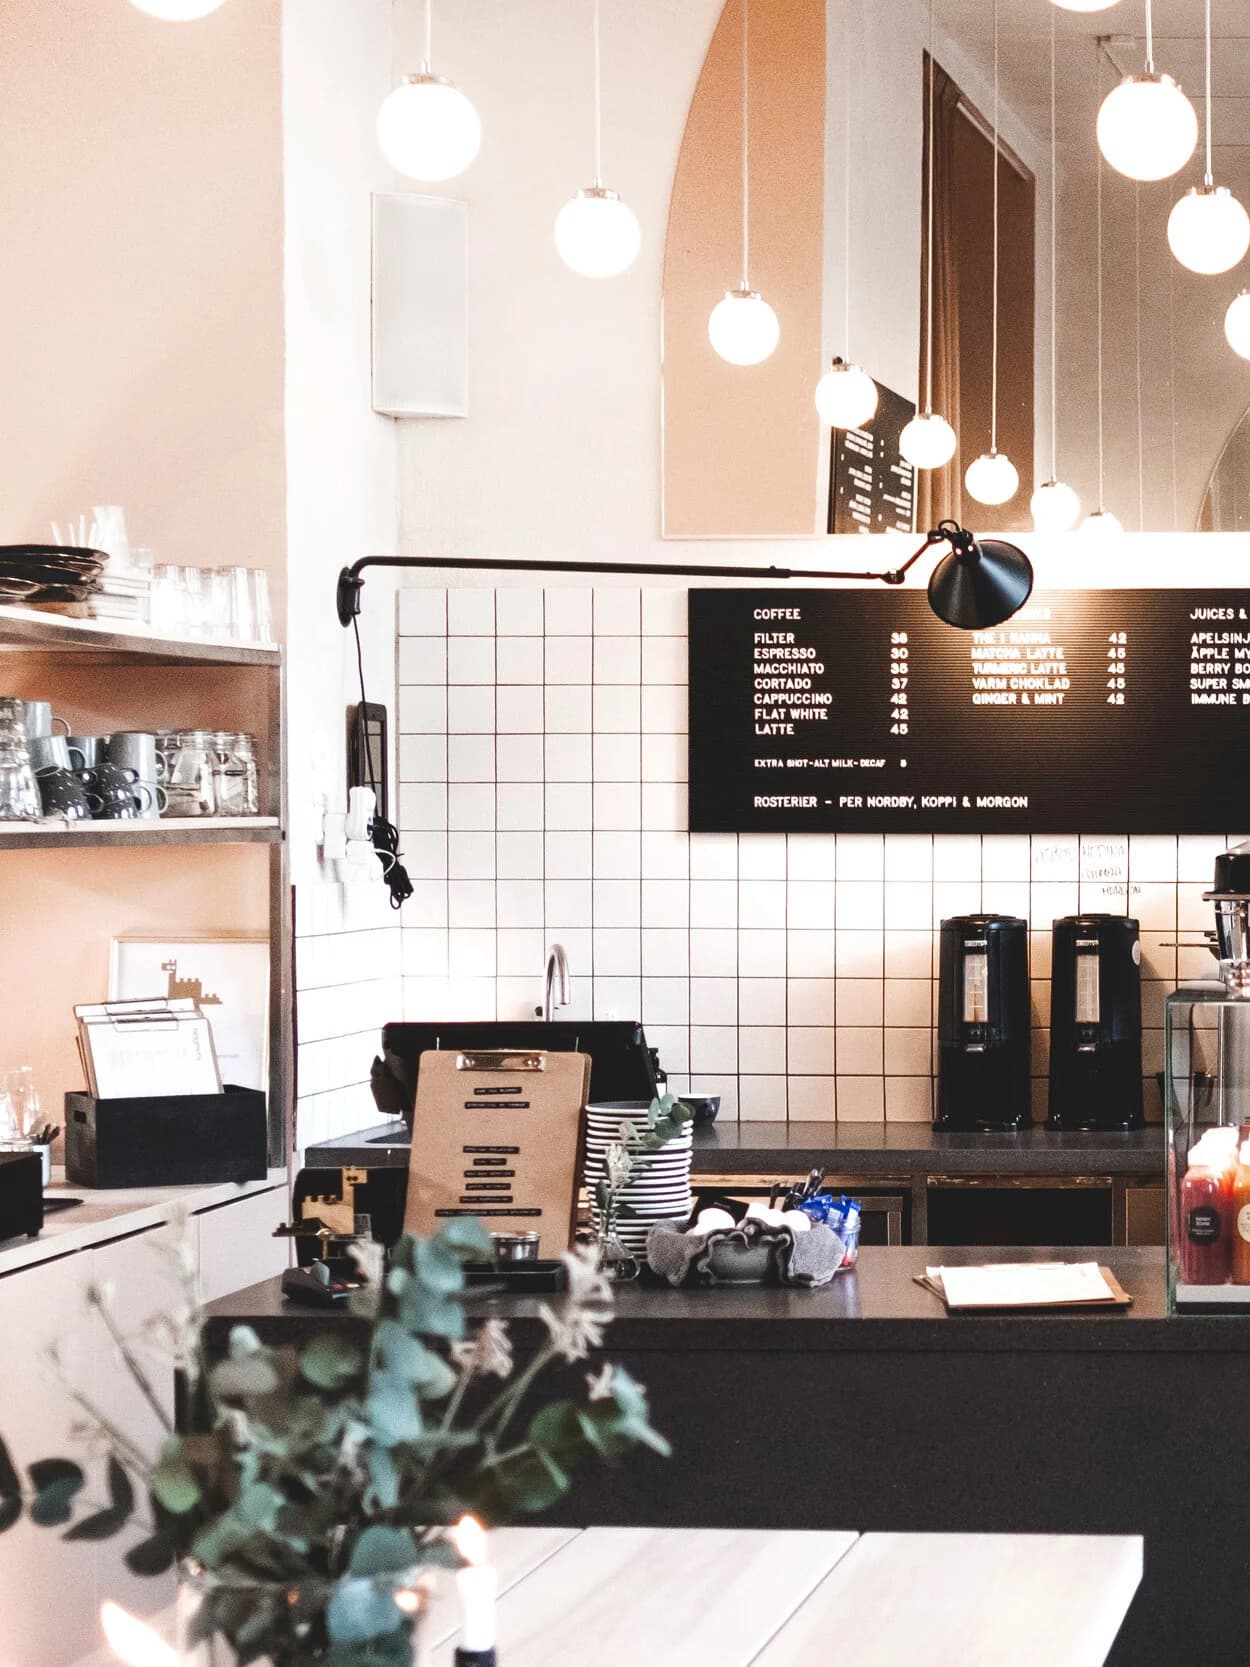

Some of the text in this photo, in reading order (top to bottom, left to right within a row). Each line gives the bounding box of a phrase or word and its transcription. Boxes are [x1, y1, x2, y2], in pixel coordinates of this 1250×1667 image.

[754, 609, 801, 620] COFFEE
[1190, 608, 1234, 620] JUICES
[1239, 608, 1248, 620] &
[754, 633, 795, 644] FILTER
[1109, 632, 1127, 644] 42
[754, 648, 908, 659] ESPRESSO 30
[1026, 648, 1064, 659] LATTE
[1107, 648, 1126, 659] 45
[1191, 646, 1229, 659] ÄPPLE
[754, 663, 908, 674] MACCHIATO 35
[1031, 663, 1066, 674] LATTE
[1107, 663, 1126, 674] 45
[1190, 663, 1230, 674] BERRY
[754, 678, 908, 689] CORTADO 37
[972, 678, 1126, 689] VARM CHOKLAD 45
[1190, 678, 1227, 690] SUPER
[754, 693, 908, 705] CAPPUCCINO 42
[972, 693, 1016, 704] GINGER
[1107, 693, 1125, 704] 42
[1191, 693, 1237, 705] IMMUNE
[755, 708, 909, 720] FLAT WHITE 42
[755, 724, 909, 735] LATTE 45
[754, 759, 784, 768] EXTRA
[754, 796, 818, 808] ROSTERIER
[839, 796, 862, 808] PER
[867, 796, 917, 810] NORDBY,
[921, 796, 957, 808] KOPPI
[962, 797, 971, 808] &
[976, 796, 1028, 808] MORGON
